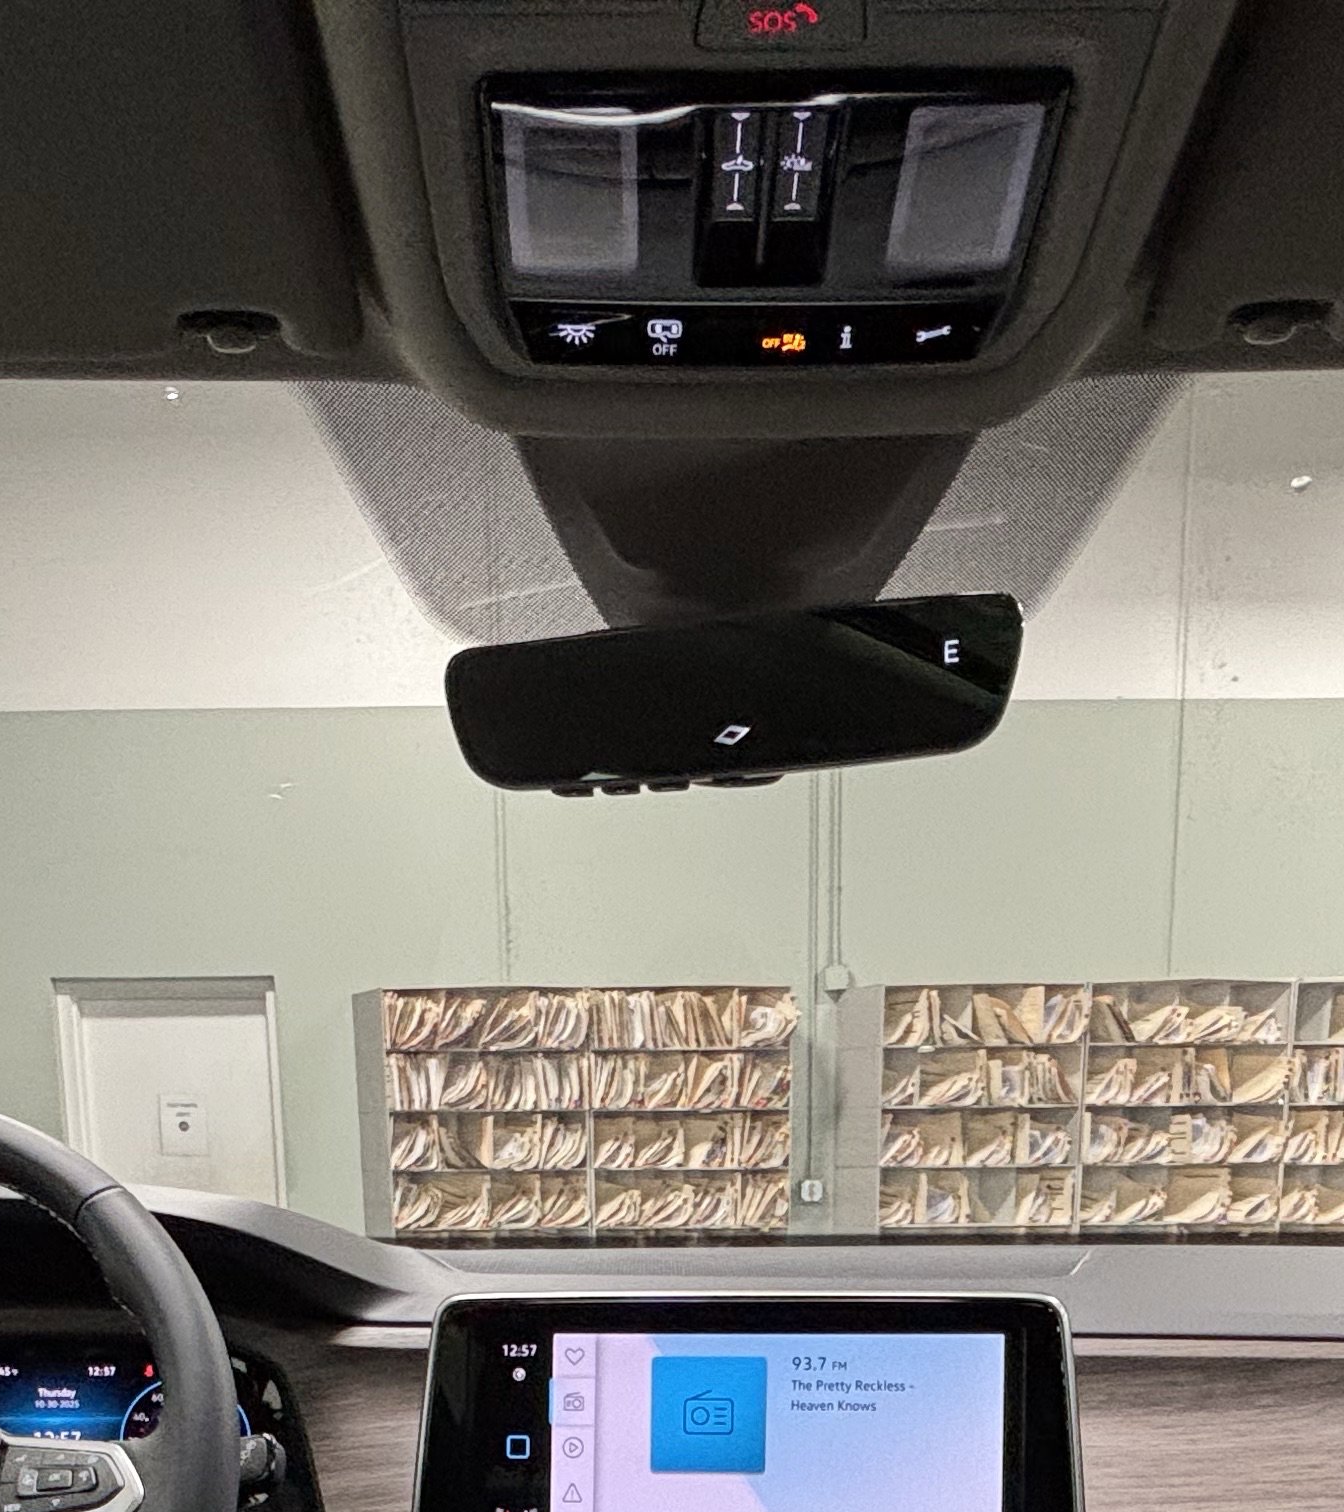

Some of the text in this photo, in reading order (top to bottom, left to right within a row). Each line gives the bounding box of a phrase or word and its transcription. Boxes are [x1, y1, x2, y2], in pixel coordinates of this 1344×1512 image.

[750, 11, 797, 32] SOS
[652, 344, 677, 356] OFF
[944, 639, 959, 663] E
[502, 1344, 537, 1357] 12:57
[792, 1356, 847, 1371] 93.7 FM
[38, 1387, 77, 1399] Thursday
[791, 1380, 813, 1391] The
[816, 1380, 852, 1394] Pretty
[855, 1380, 906, 1392] Reckless
[791, 1400, 877, 1412] Heaven Knows
